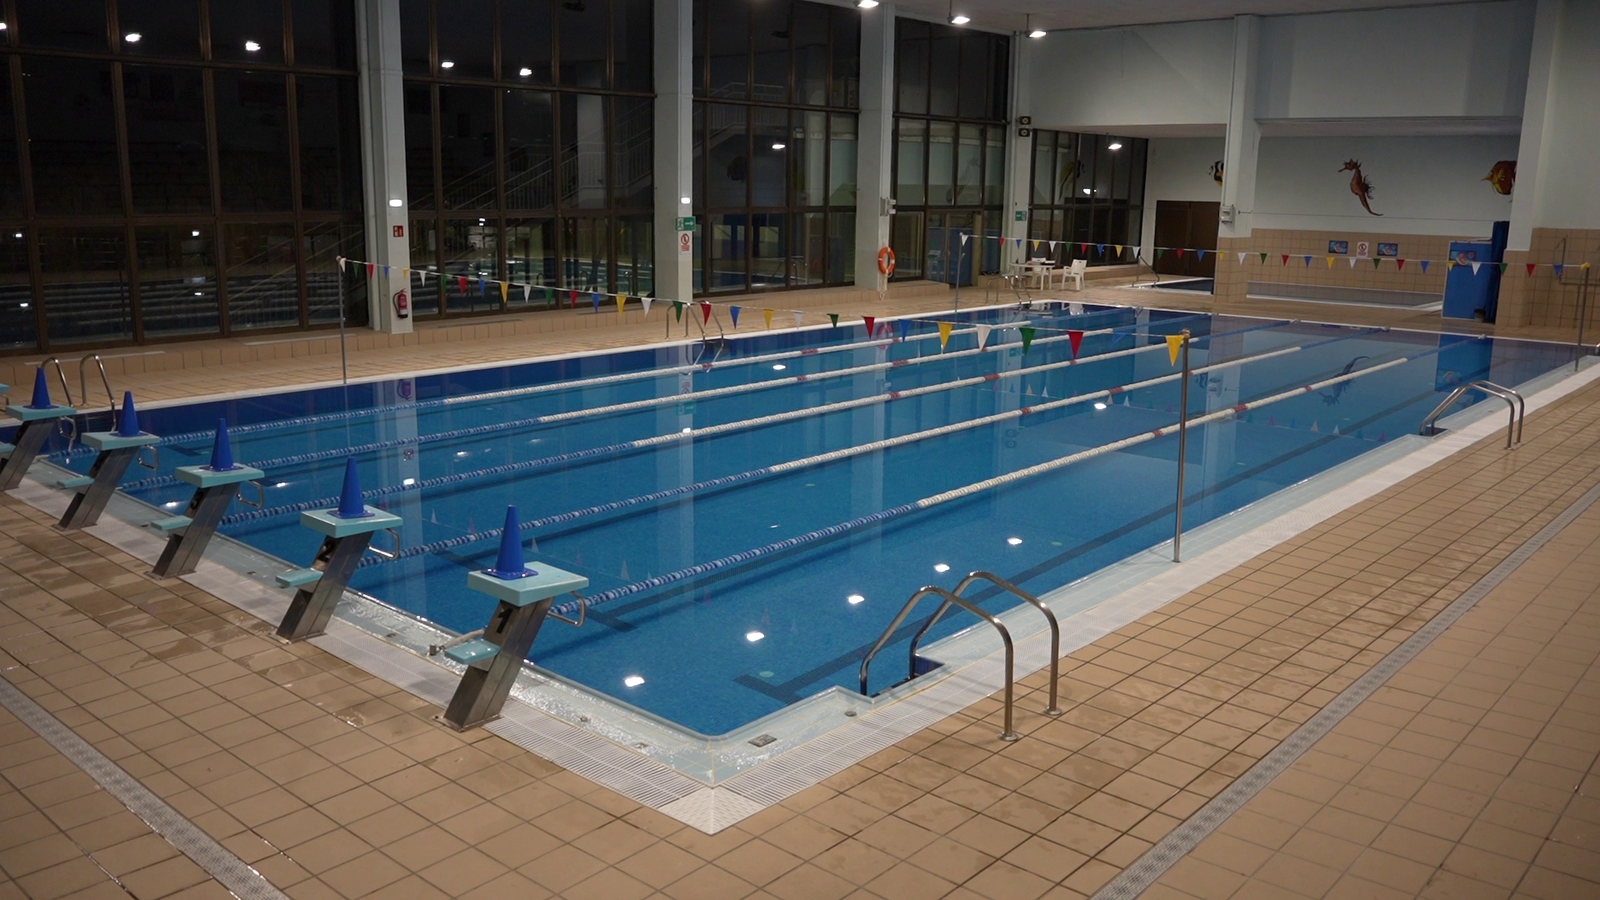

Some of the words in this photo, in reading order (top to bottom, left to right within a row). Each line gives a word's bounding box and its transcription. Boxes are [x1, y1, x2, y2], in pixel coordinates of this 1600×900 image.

[190, 491, 203, 510] 3
[317, 539, 335, 562] 2
[496, 608, 513, 634] 1
